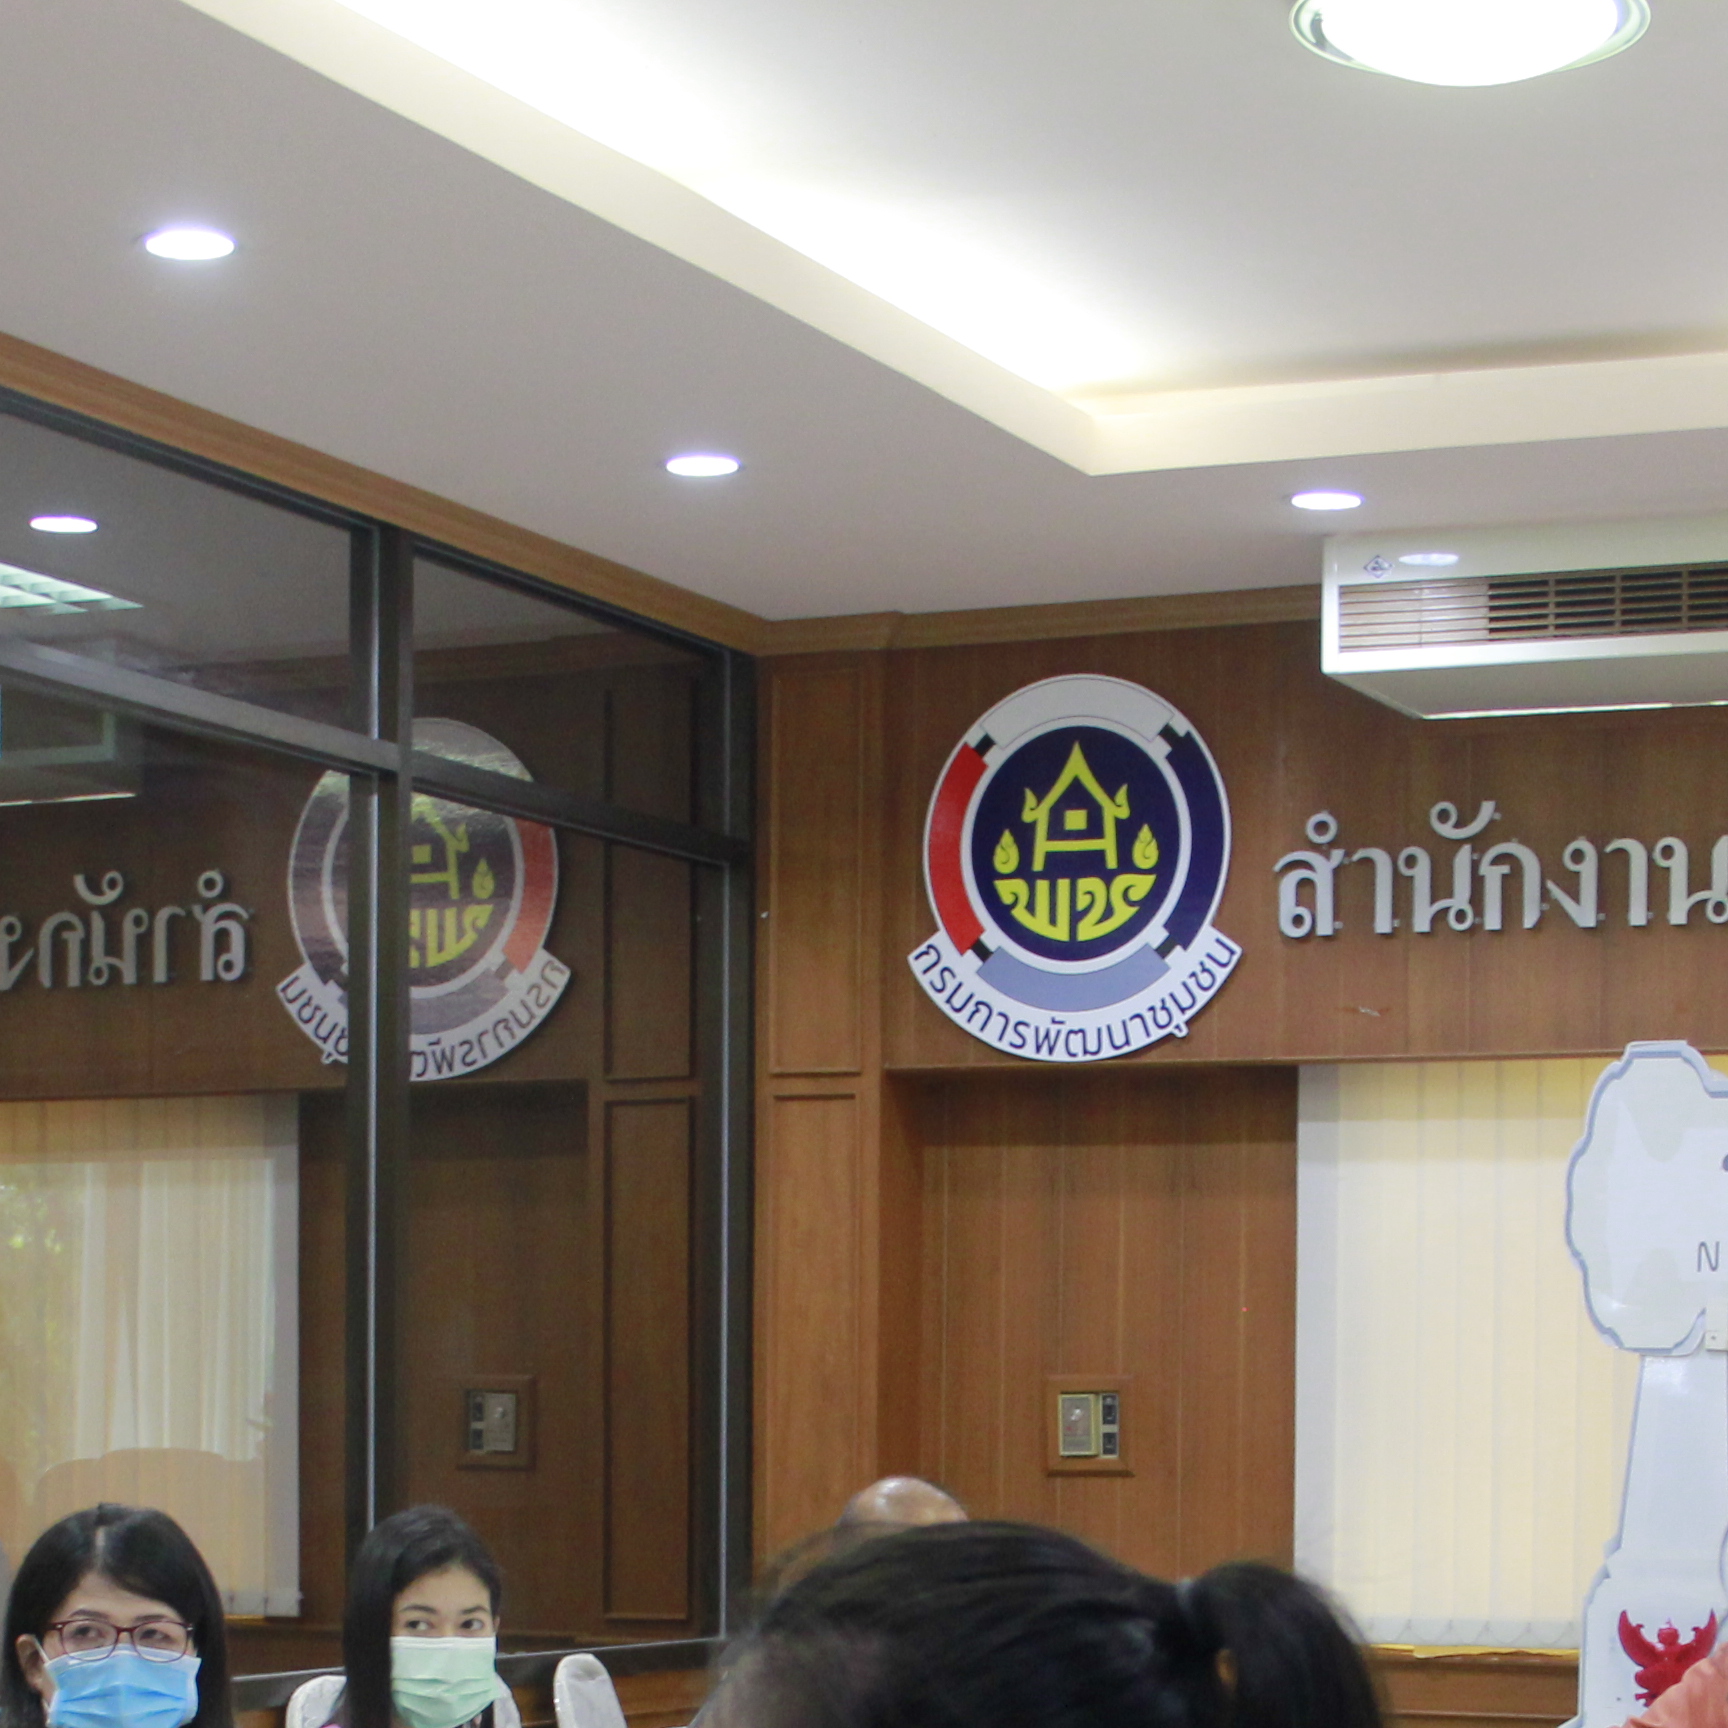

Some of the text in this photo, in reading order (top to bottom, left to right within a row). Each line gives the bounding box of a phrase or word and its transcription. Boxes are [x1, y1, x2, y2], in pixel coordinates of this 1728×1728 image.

[913, 937, 1238, 1058] กรมการพัฒนาชุมชน
